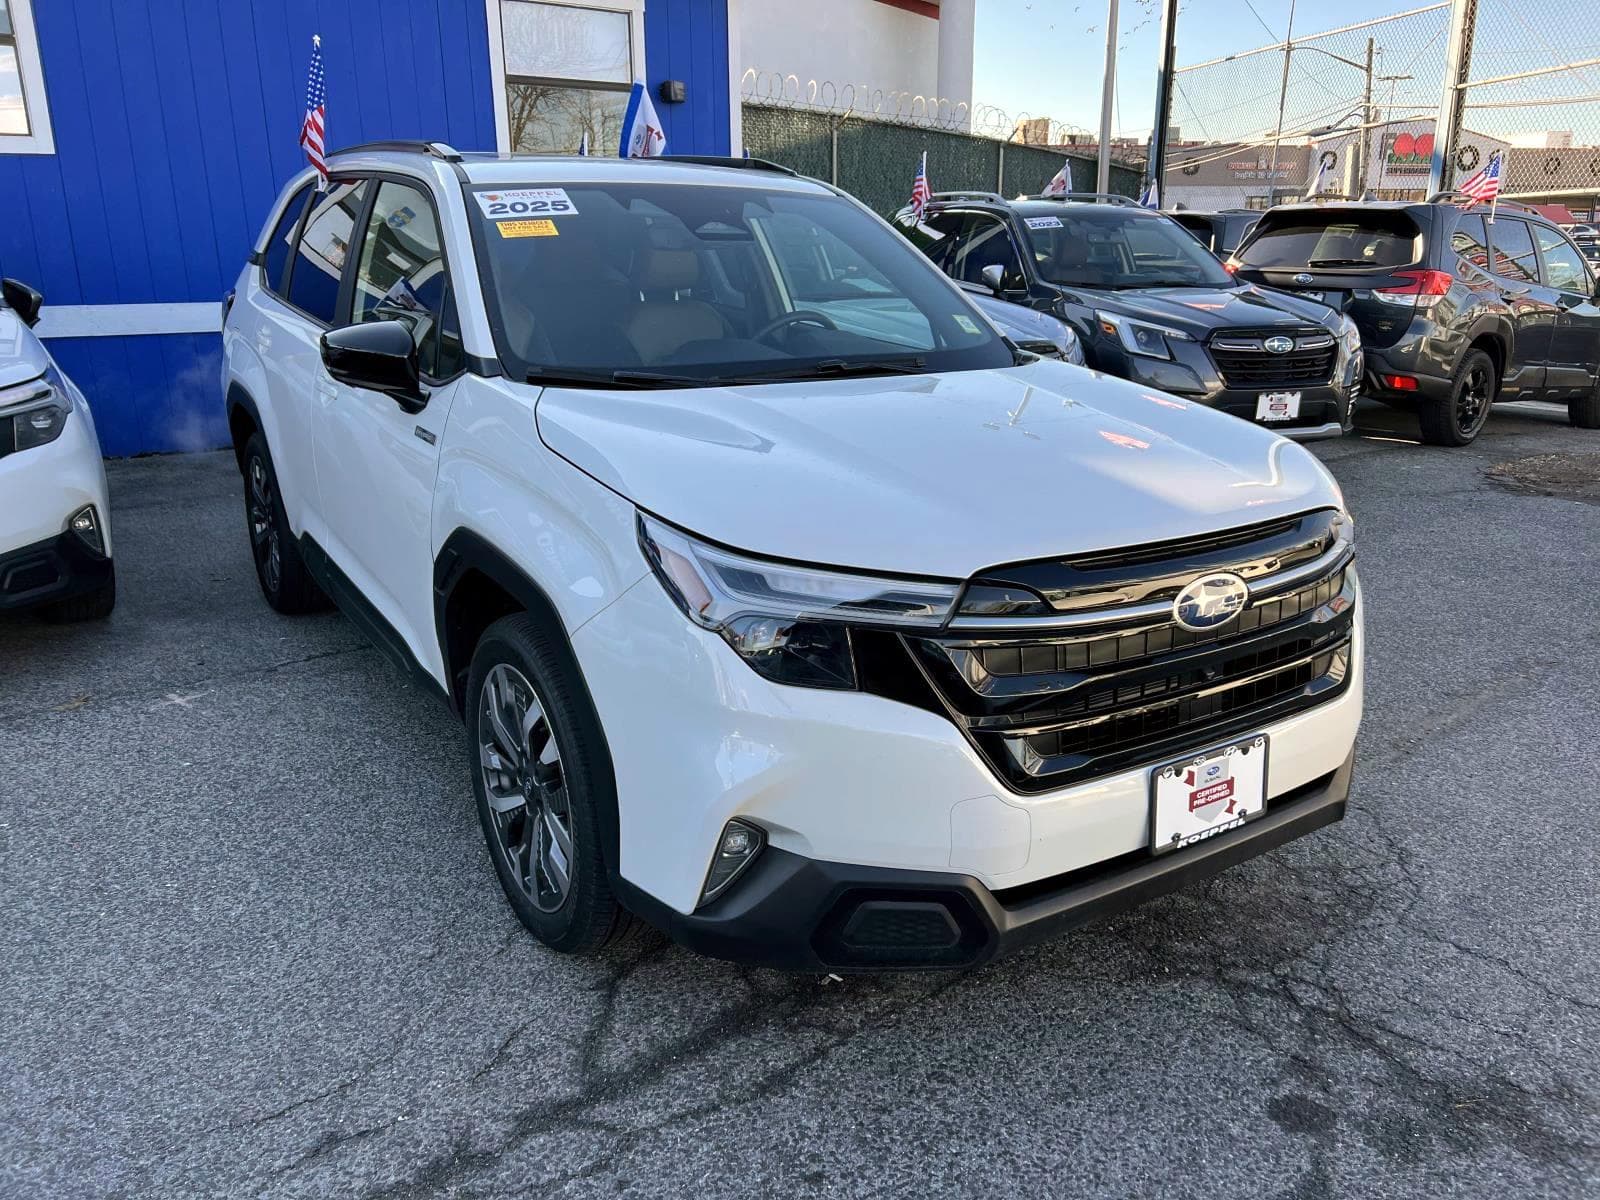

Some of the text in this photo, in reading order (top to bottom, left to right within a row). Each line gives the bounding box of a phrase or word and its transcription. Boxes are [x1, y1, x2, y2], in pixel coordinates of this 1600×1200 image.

[488, 200, 570, 214] 2025
[1193, 789, 1230, 806] PRE-OWNED
[1197, 783, 1228, 799] CERTIFIED
[1176, 817, 1246, 849] KOEPPEL
